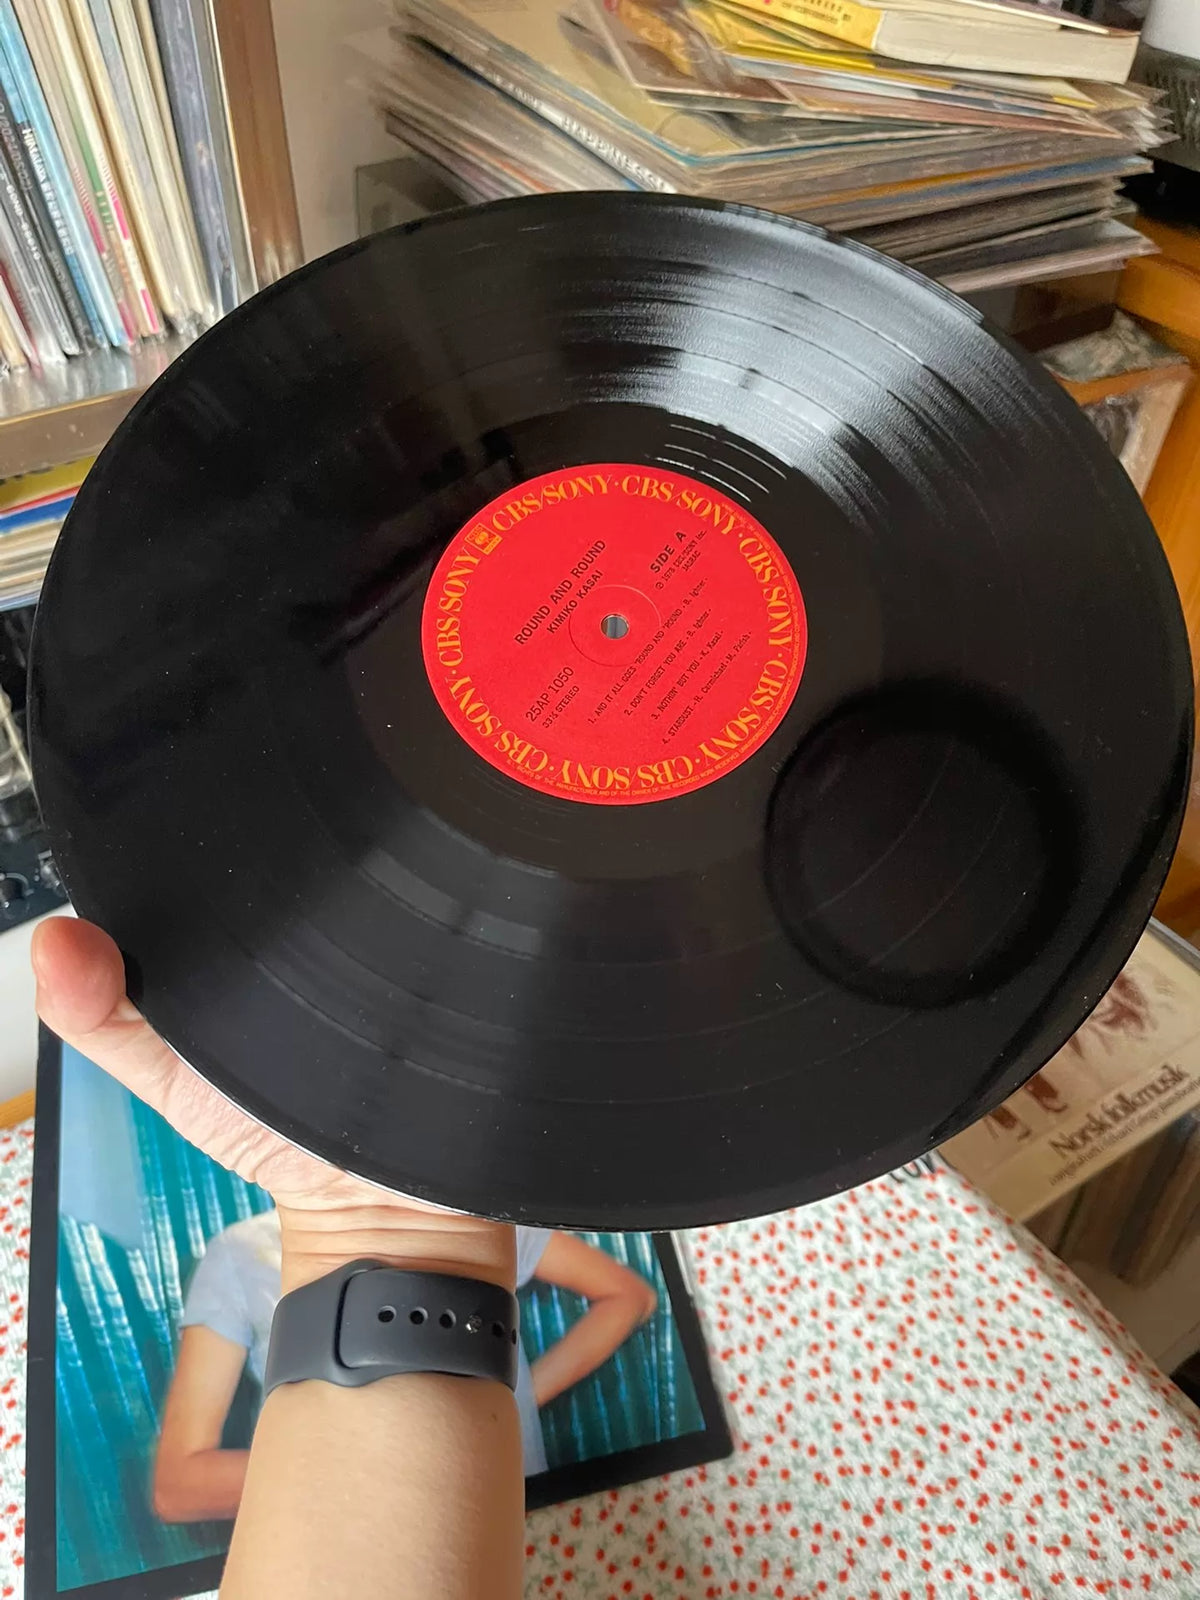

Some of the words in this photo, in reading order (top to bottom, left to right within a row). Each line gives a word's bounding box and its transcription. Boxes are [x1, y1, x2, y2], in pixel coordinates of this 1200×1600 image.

[492, 474, 612, 532] CBS/SONY
[622, 475, 744, 535] CBS/SONY
[650, 545, 675, 574] SIDE
[675, 531, 687, 542] A
[436, 545, 481, 667] CBS/SONY
[514, 604, 551, 645] ROUND
[550, 579, 573, 605] AND
[570, 540, 606, 579] ROUND
[547, 600, 578, 634] KIMIKO
[576, 570, 603, 600] KASAI
[739, 537, 793, 654] CBS/SONY
[525, 692, 551, 722] 25AP
[548, 666, 574, 694] 1050
[555, 685, 580, 714] STEREO
[595, 702, 608, 716] AND
[604, 693, 613, 703] IT
[611, 682, 624, 695] ALL
[622, 666, 637, 683] GOES
[654, 631, 665, 645] AND
[630, 689, 648, 708] DON'T
[645, 665, 666, 690] FORGET
[664, 651, 677, 666] YOU
[674, 639, 687, 654] ARE
[657, 686, 679, 712] NOTHIN'
[677, 672, 688, 688] BUT
[686, 659, 700, 674] YOU
[445, 675, 549, 773] CBS/SONY
[667, 706, 694, 737] STARDUST
[697, 660, 789, 768] CBS/SONY
[555, 755, 694, 792] CBS/SONY
